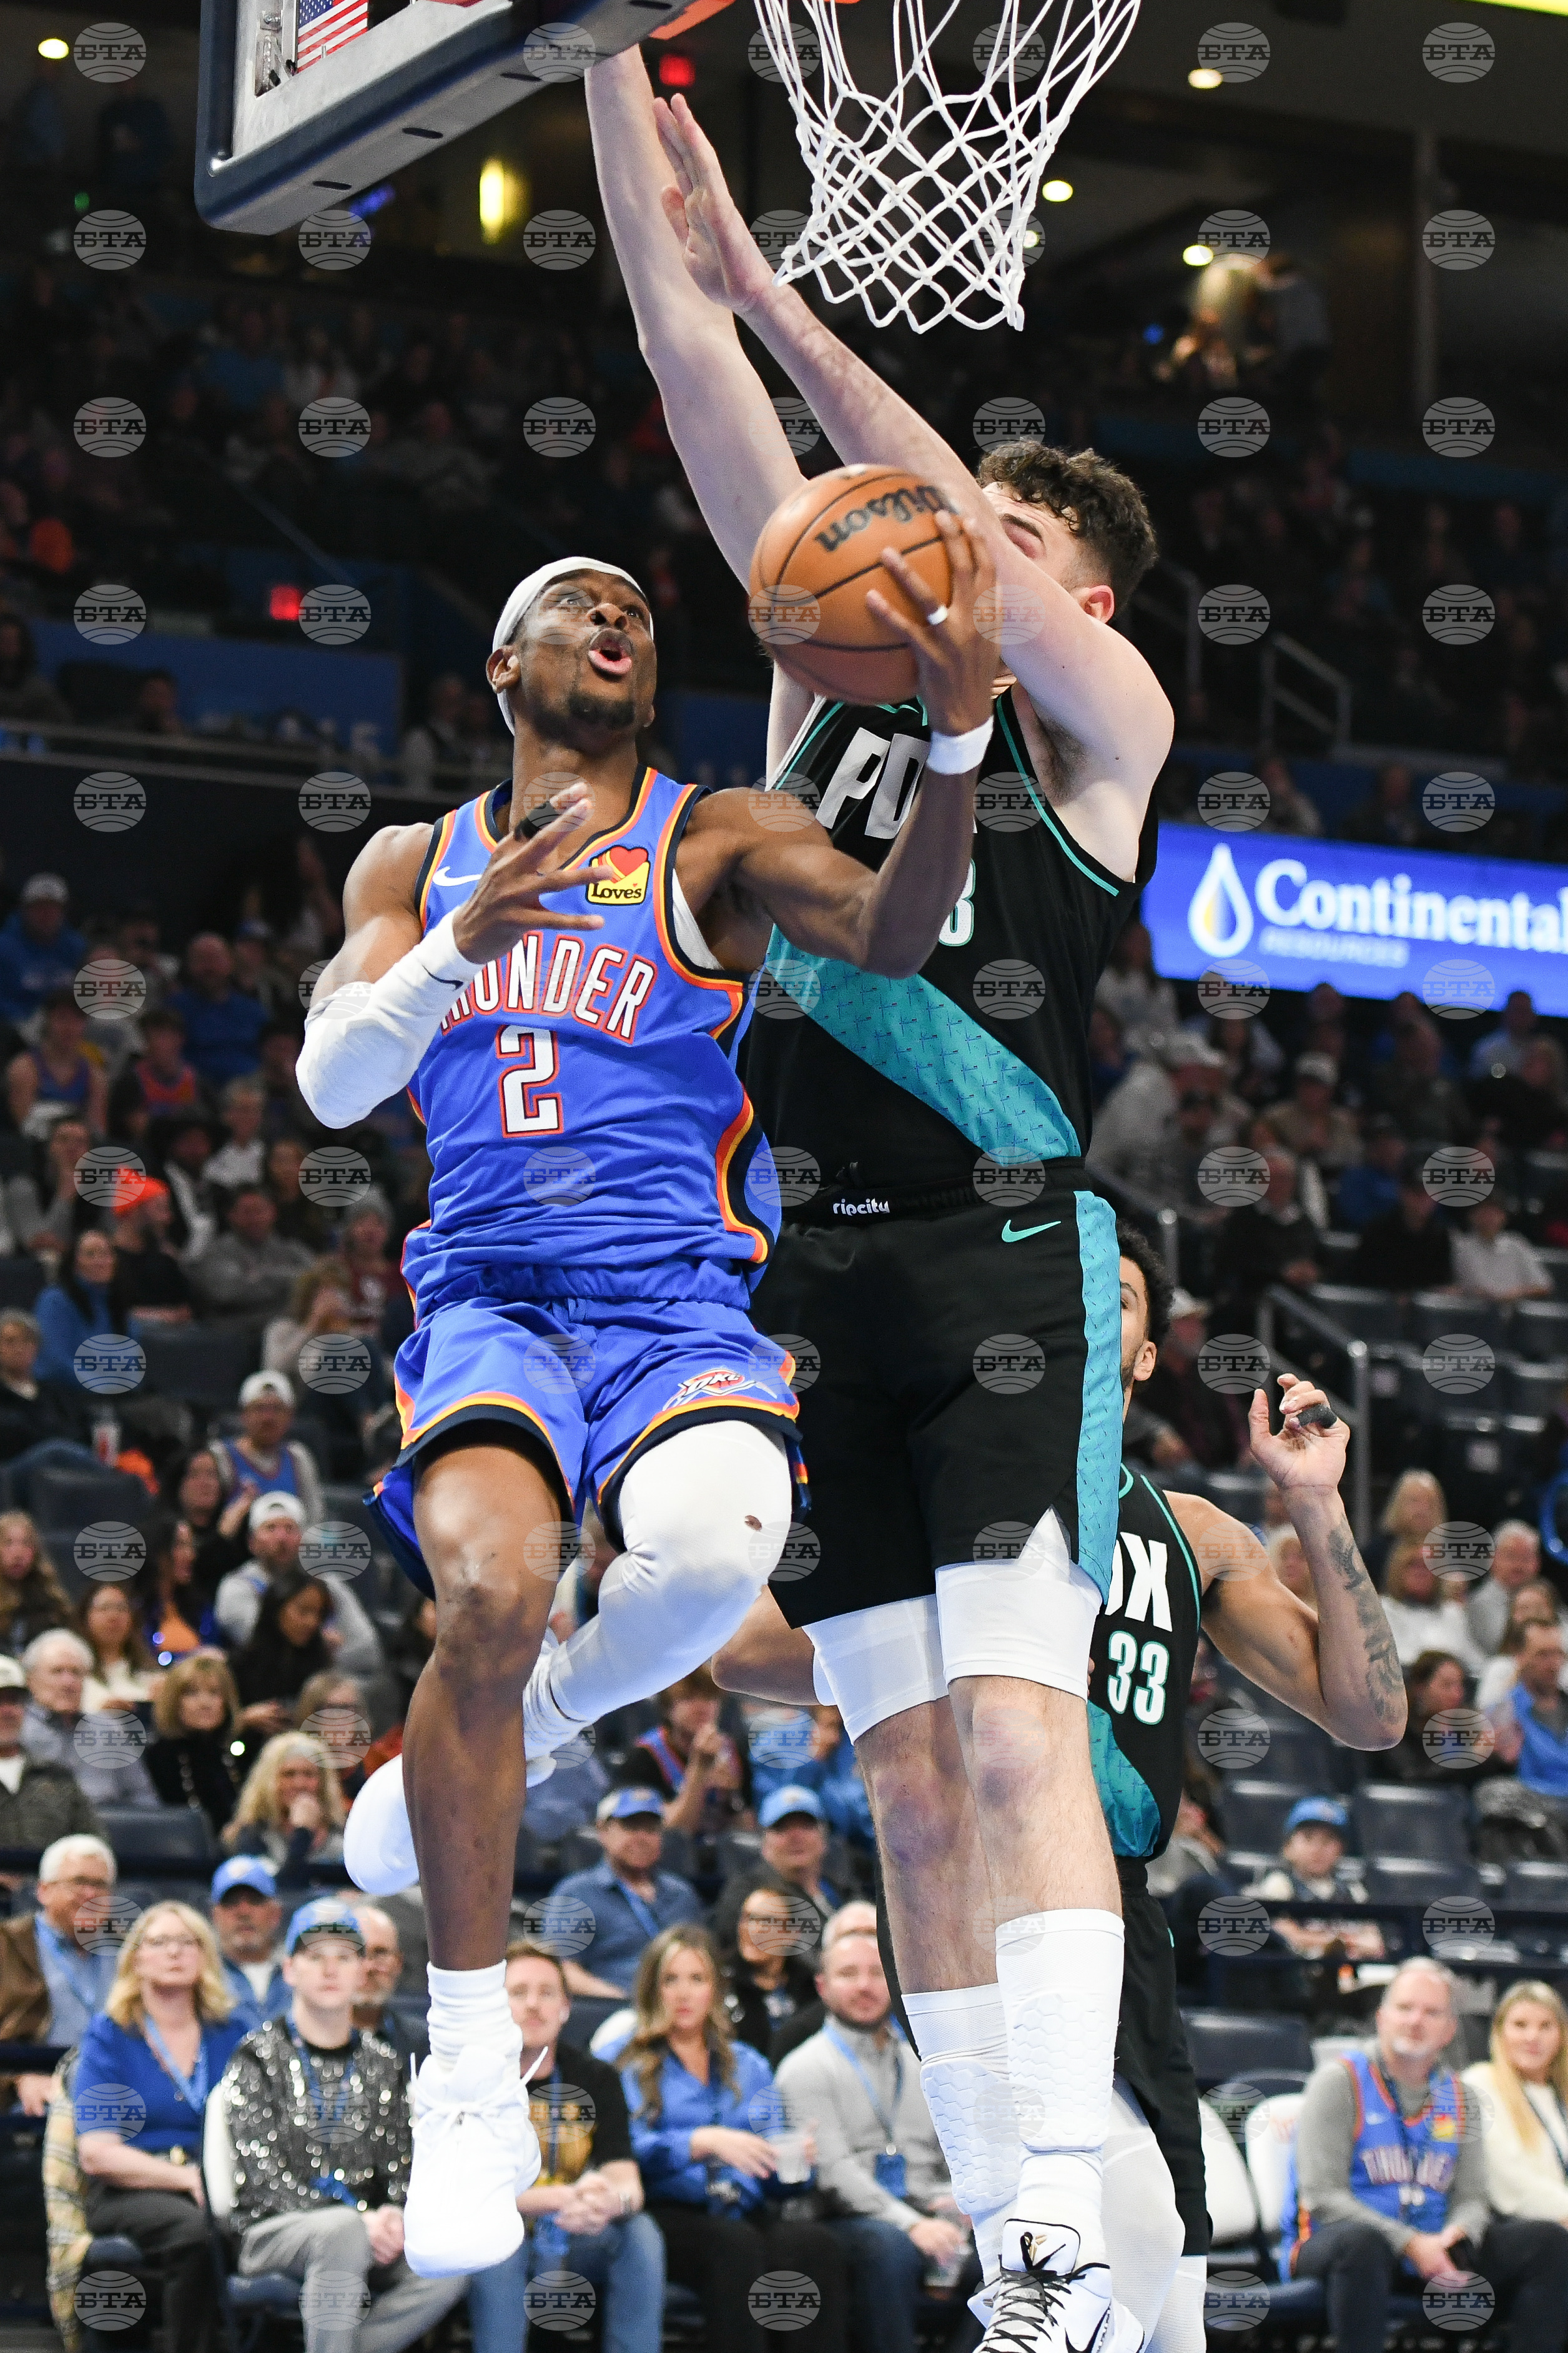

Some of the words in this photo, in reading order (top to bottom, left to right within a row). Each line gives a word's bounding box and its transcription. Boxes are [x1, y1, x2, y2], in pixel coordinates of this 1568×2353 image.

[816, 727, 977, 839] PD
[440, 930, 658, 1045] UNDER
[495, 1023, 564, 1138] 2
[832, 1198, 890, 1216] ripcity
[1107, 1630, 1170, 1725] 33
